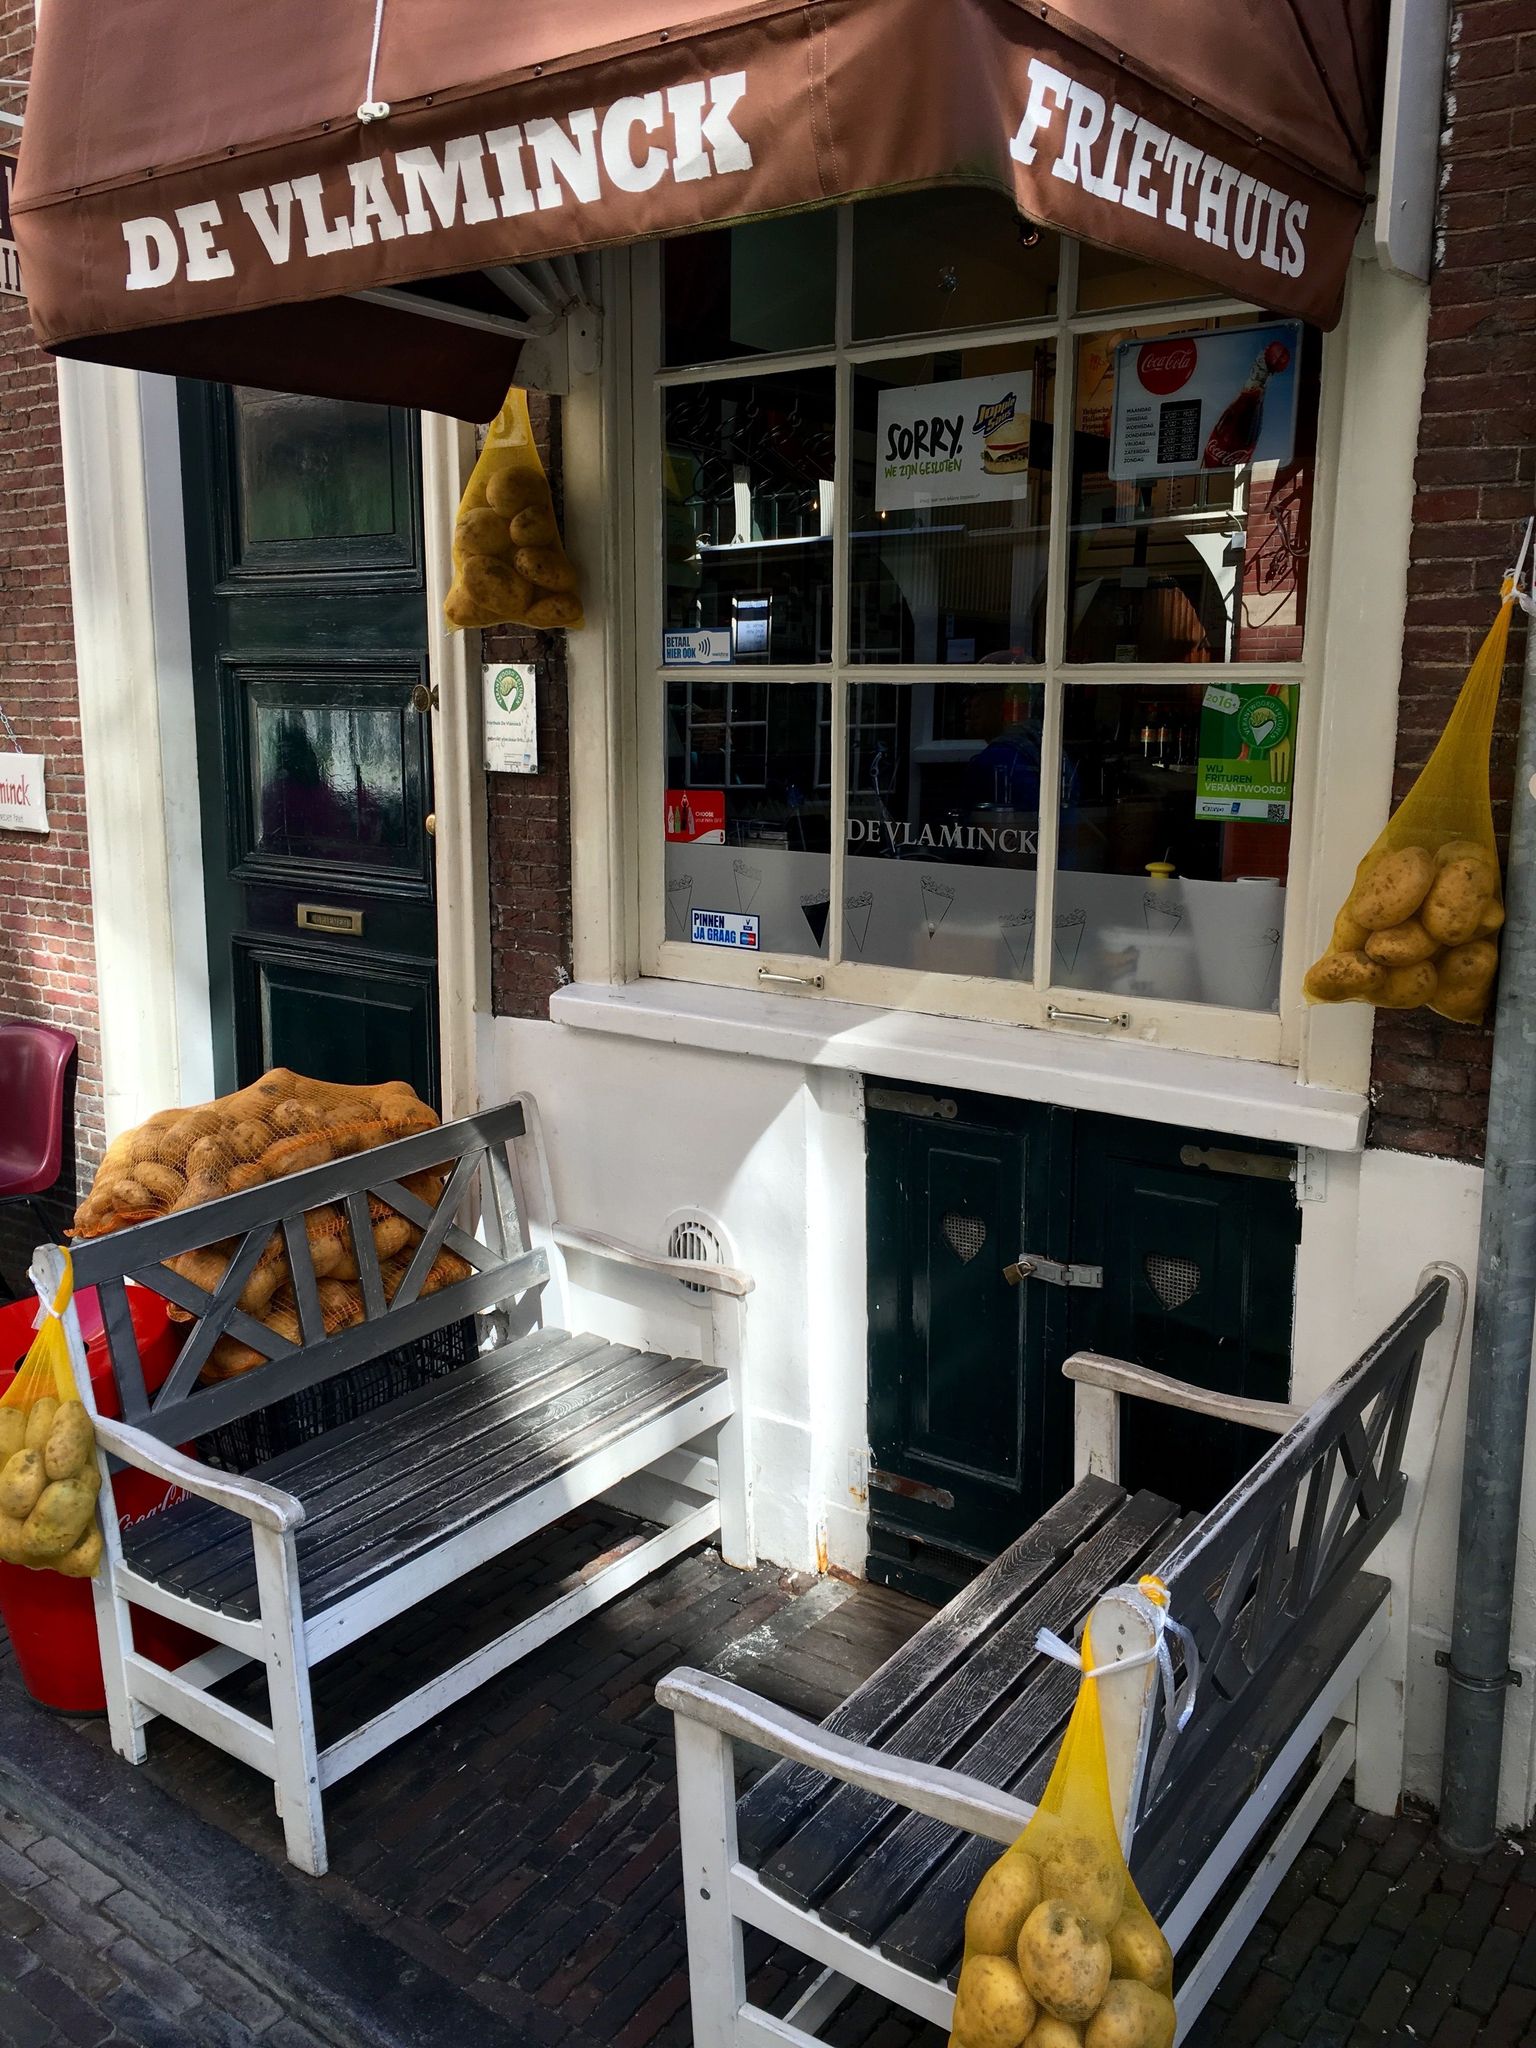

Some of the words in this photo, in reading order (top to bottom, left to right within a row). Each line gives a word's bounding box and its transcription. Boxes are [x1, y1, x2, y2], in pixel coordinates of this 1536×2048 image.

[1009, 57, 1310, 278] FRIETHUIS
[122, 199, 235, 291] DE
[239, 71, 753, 265] VLAMINCK
[1141, 349, 1193, 373] Coca-Cola
[884, 464, 897, 479] WE
[918, 458, 963, 475] GESLOTEN
[666, 636, 690, 647] BETAAL
[666, 648, 682, 658] HIER
[682, 648, 696, 658] OOK
[1206, 694, 1233, 709] 2016
[1205, 764, 1224, 773] WIJ
[1204, 773, 1253, 784] FRITUREN
[1204, 782, 1287, 795] VERANTWOORD!
[694, 913, 725, 928] PINNEN
[694, 927, 705, 940] JA
[707, 928, 736, 943] GRAAG
